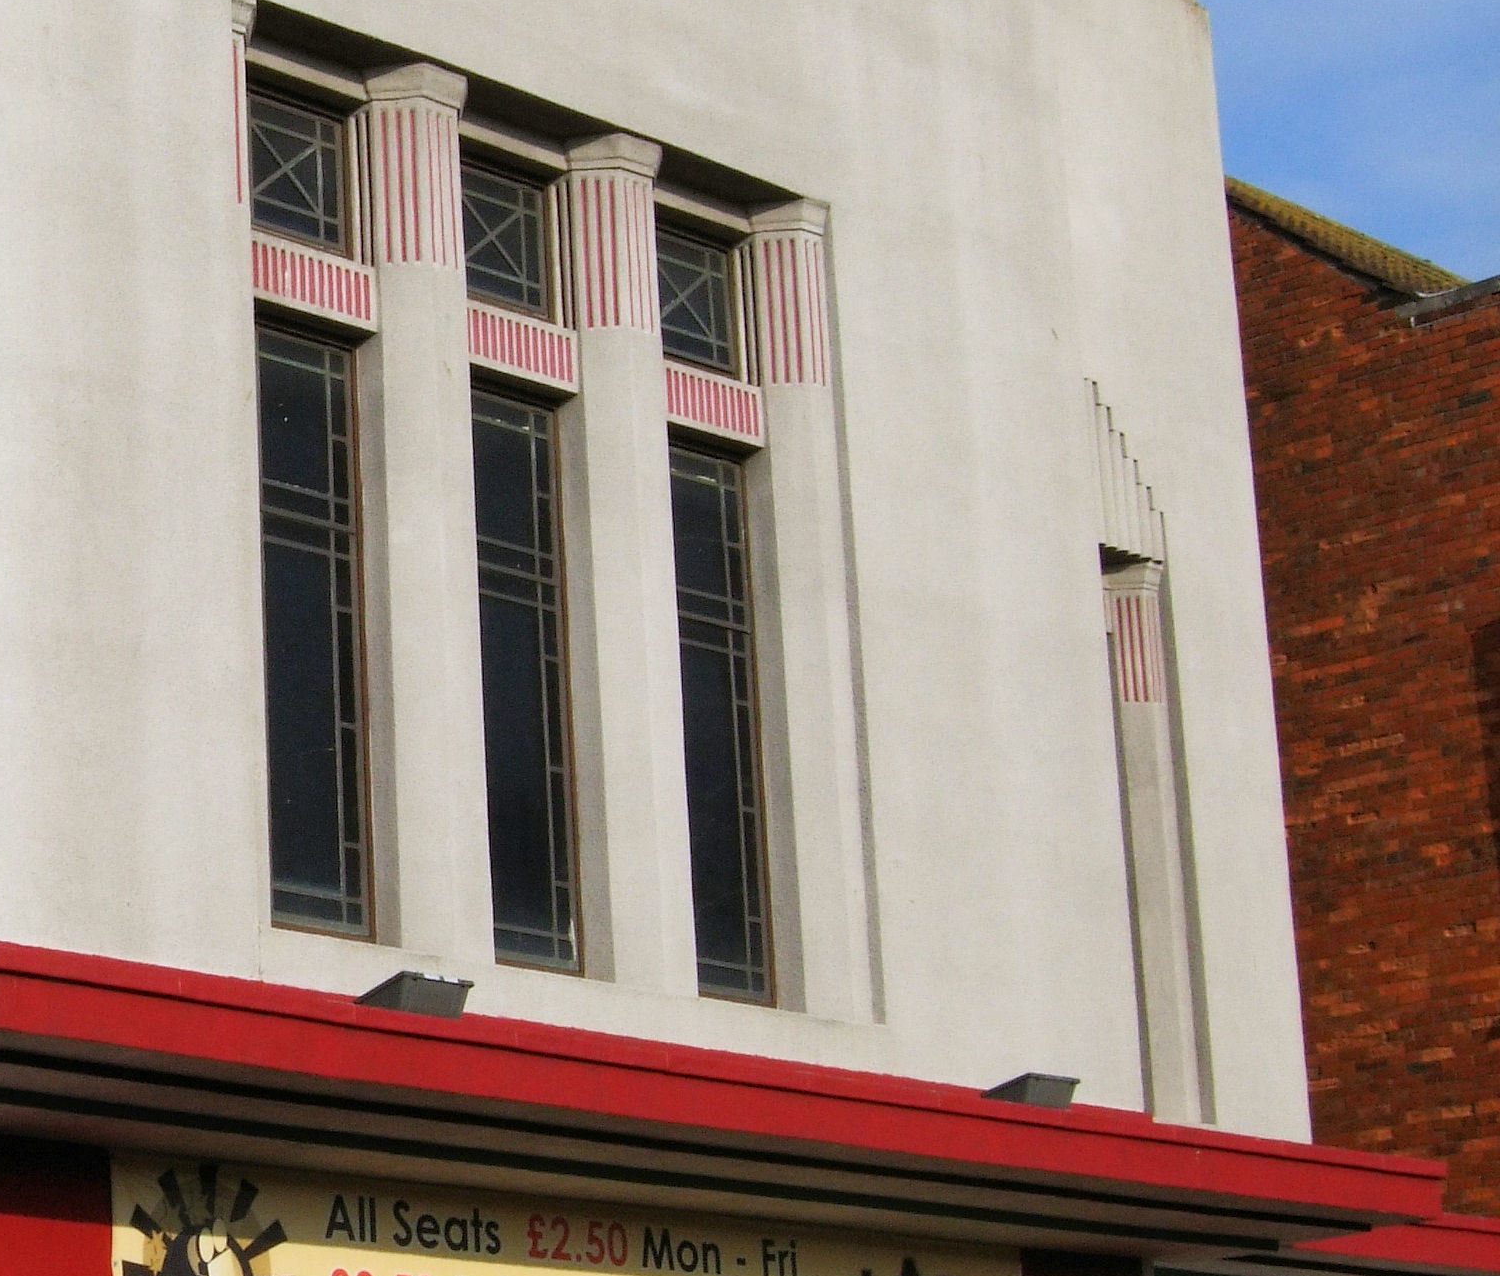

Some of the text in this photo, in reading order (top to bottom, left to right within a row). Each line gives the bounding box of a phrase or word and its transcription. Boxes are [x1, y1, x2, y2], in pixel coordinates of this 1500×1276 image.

[326, 1194, 377, 1243] All
[392, 1199, 501, 1255] Seats
[527, 1213, 628, 1267] £2.50
[642, 1227, 722, 1275] Mon
